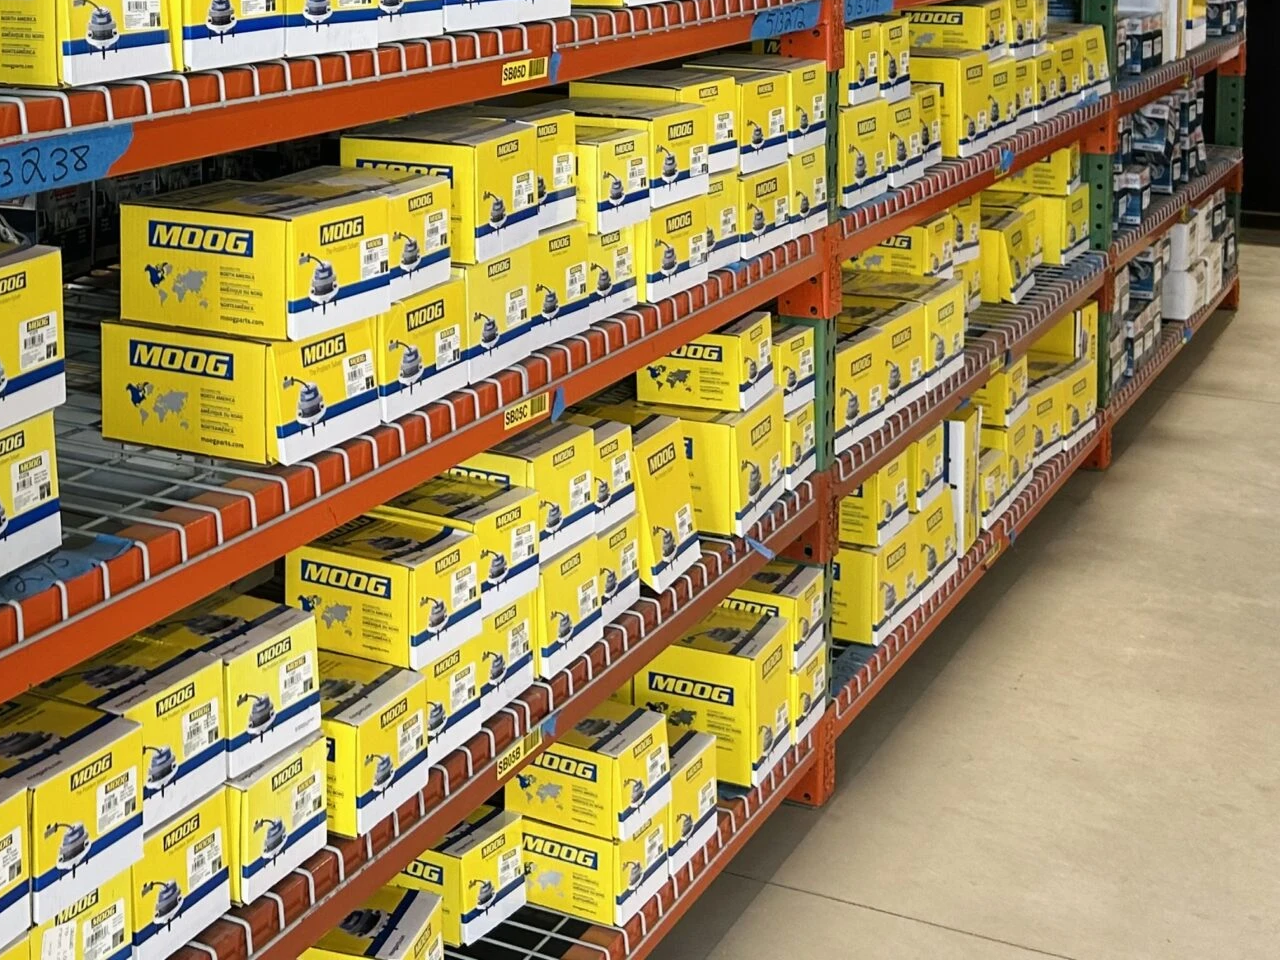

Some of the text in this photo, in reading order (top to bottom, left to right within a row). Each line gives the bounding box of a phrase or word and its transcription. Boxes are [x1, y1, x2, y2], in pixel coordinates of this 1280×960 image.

[905, 12, 963, 24] MOOG
[504, 65, 526, 80] SB05D
[669, 122, 692, 137] MOOG
[409, 195, 431, 209] MOOG
[153, 224, 250, 253] MOOG
[322, 220, 362, 243] MOOG
[408, 302, 443, 328] MOOG
[135, 344, 230, 377] MOOG
[303, 336, 345, 365] MOOG
[506, 405, 527, 425] SB05C
[20, 458, 42, 472] MOOG
[649, 446, 674, 471] MOOG
[305, 564, 388, 596] MOOG
[157, 686, 193, 714] MOOG
[652, 676, 730, 701] MOOG
[382, 701, 406, 725] MOOG
[72, 756, 111, 787] MOOG
[498, 749, 521, 775] SB05B
